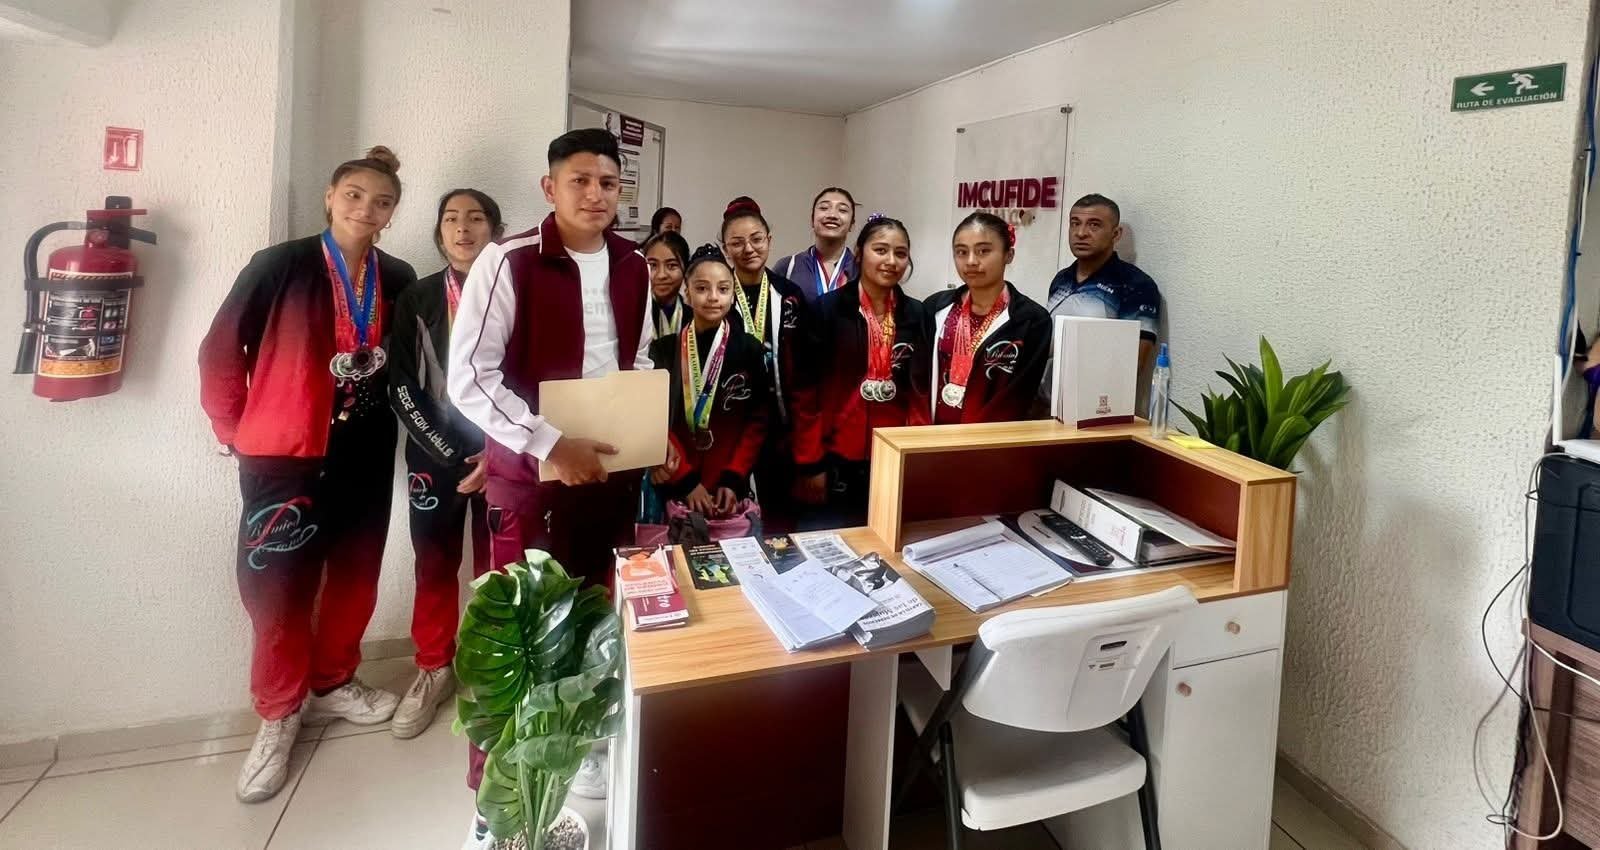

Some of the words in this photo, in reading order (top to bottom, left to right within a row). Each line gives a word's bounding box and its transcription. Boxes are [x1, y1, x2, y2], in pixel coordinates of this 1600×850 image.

[1456, 101, 1480, 109] RUTA
[1481, 99, 1494, 107] DE
[1495, 92, 1557, 105] EVACUACIÓN
[957, 176, 1057, 208] IMCUFIDE
[397, 385, 415, 411] 2025
[410, 410, 430, 431] KIDS
[425, 430, 454, 457] STRAY
